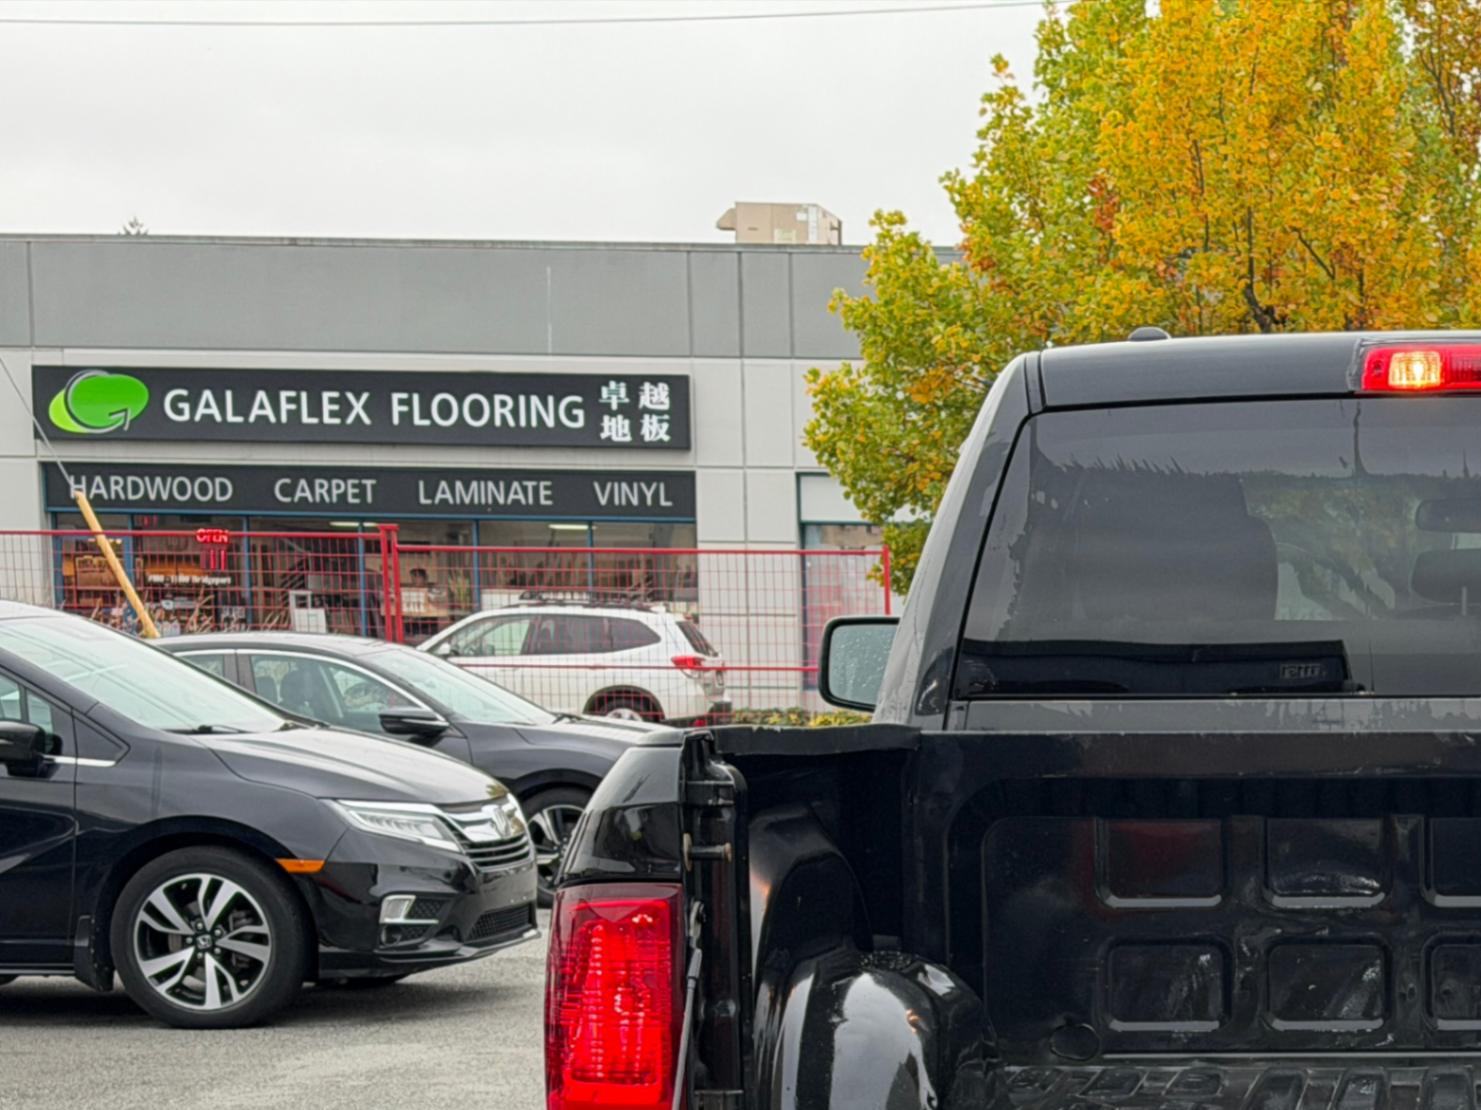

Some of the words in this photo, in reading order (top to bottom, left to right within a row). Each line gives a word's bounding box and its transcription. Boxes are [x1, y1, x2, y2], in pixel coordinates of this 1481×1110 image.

[163, 388, 372, 425] GALAFLEX
[391, 391, 585, 428] FLOORING
[599, 380, 670, 411] 卓越
[600, 413, 671, 442] 地板
[69, 475, 233, 502] HARDWOOD
[273, 478, 376, 503] CARPET
[418, 480, 553, 506] LAMINATE
[593, 481, 673, 507] VINYL
